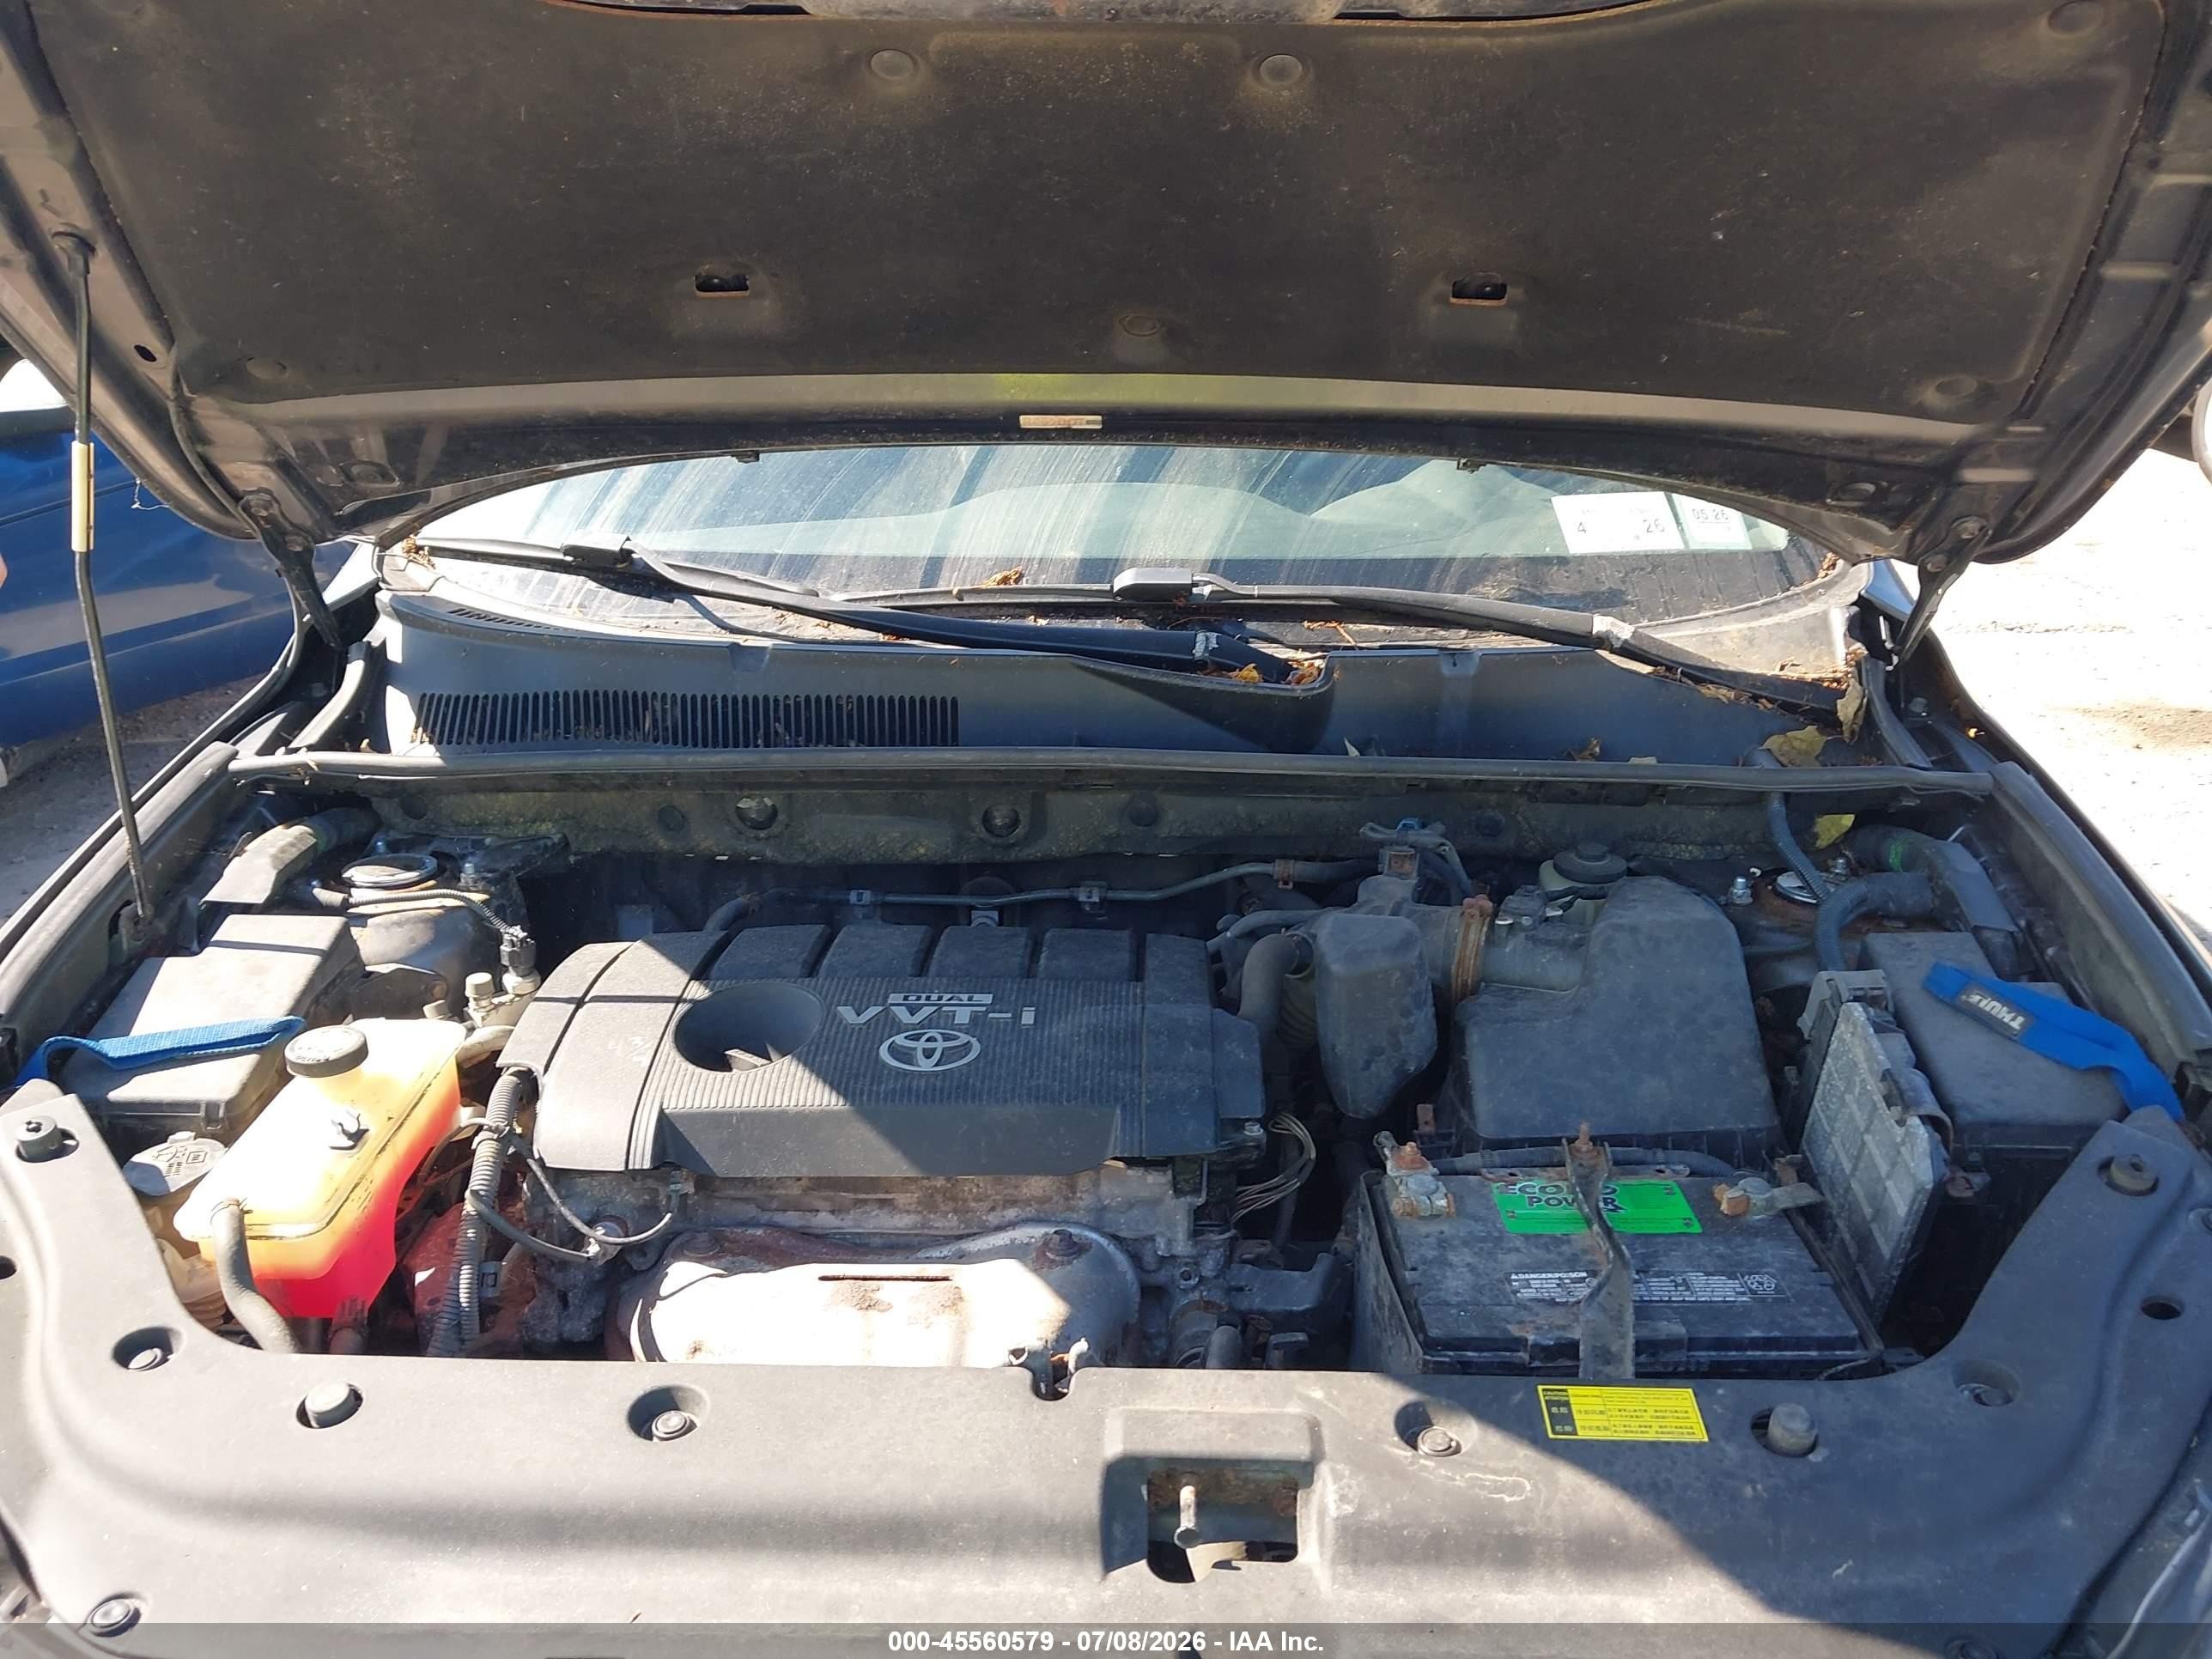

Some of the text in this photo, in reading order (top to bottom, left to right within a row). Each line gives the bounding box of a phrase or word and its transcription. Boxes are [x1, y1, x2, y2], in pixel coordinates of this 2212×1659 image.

[1576, 519, 1666, 534] 4 26
[901, 994, 985, 1003] DUAL
[836, 1006, 1036, 1024] VVT-i
[1969, 994, 2025, 1030] THULE
[1498, 1182, 1619, 1195] ECOO
